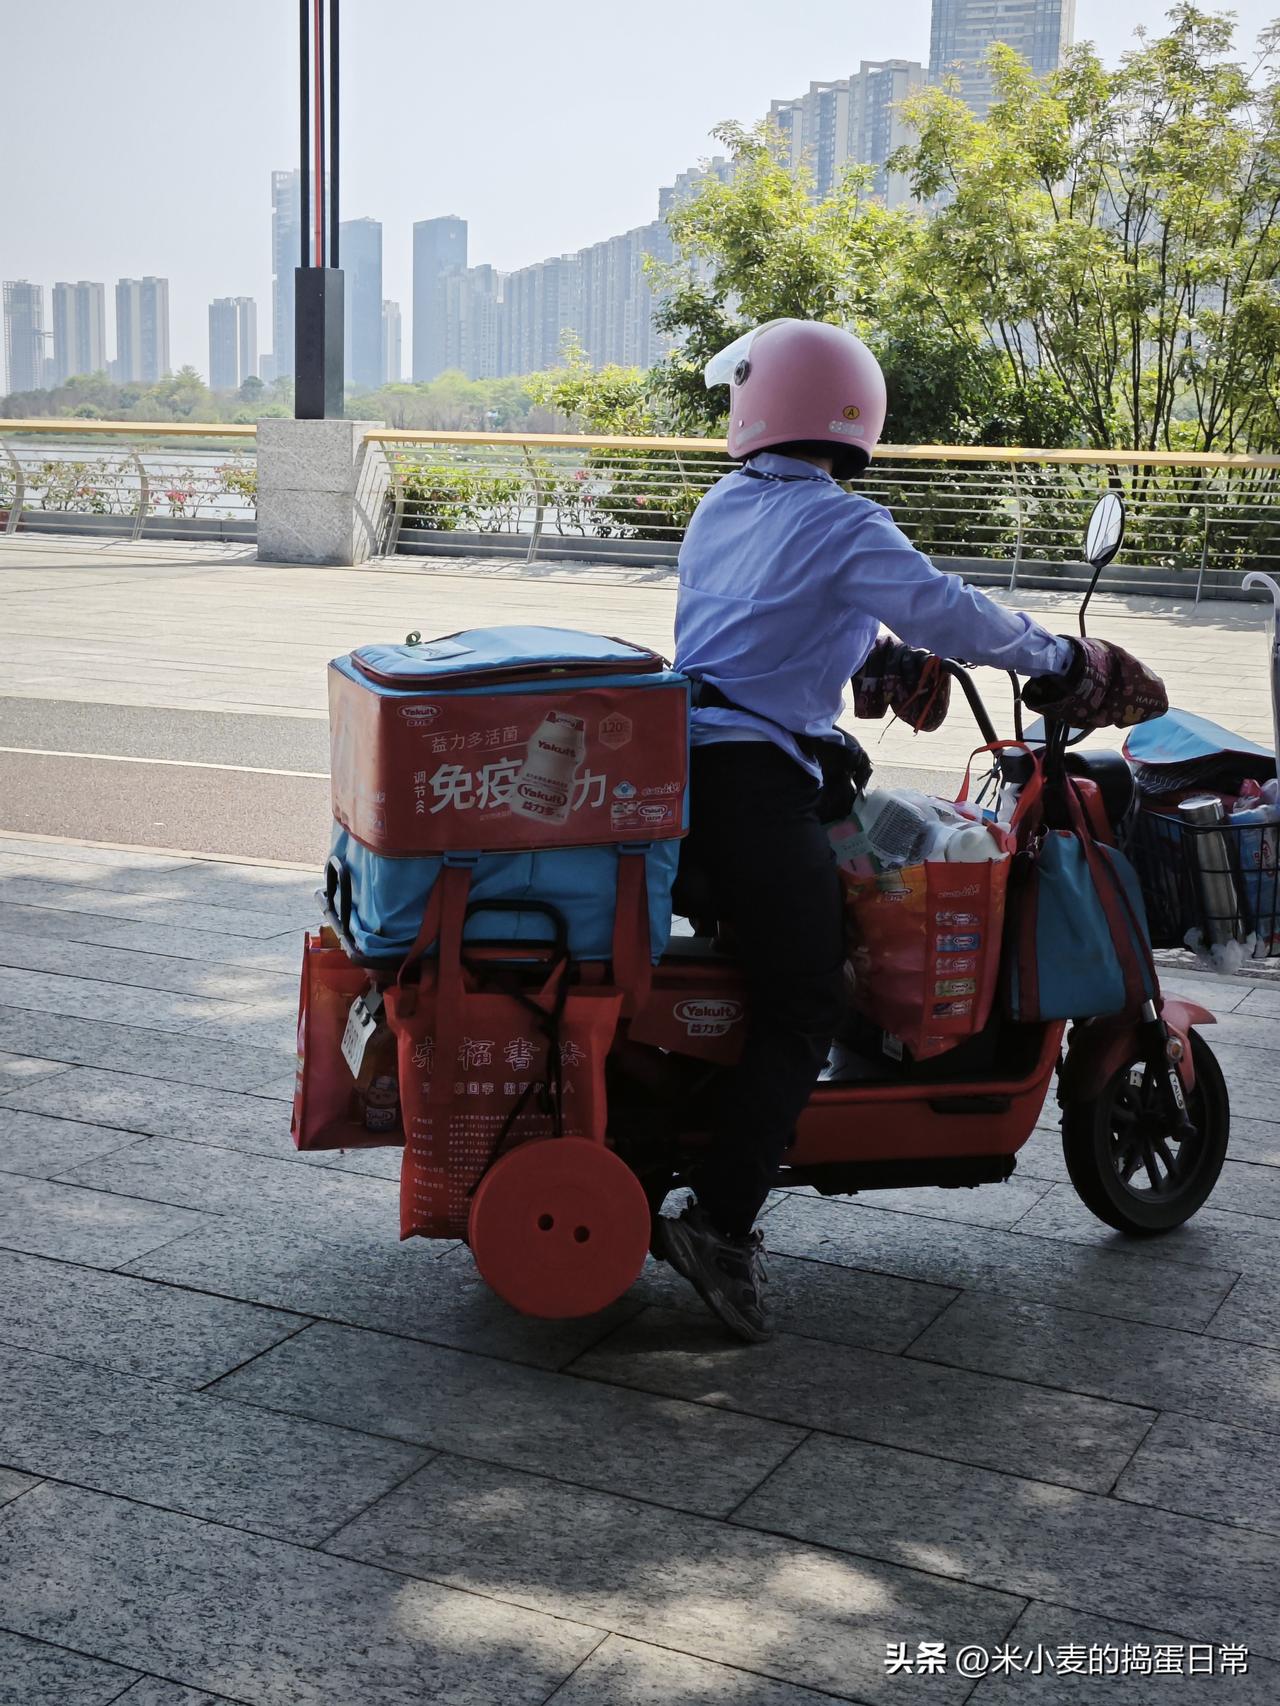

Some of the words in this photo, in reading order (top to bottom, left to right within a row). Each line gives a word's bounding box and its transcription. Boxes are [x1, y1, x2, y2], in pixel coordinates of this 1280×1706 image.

[404, 706, 434, 716] Yakult
[431, 725, 520, 754] 益力多活菌
[537, 740, 577, 758] Yakult
[413, 770, 427, 799] 调节
[429, 756, 607, 815] 免疫力
[523, 786, 562, 804] Yakult
[687, 1006, 731, 1017] Yakult
